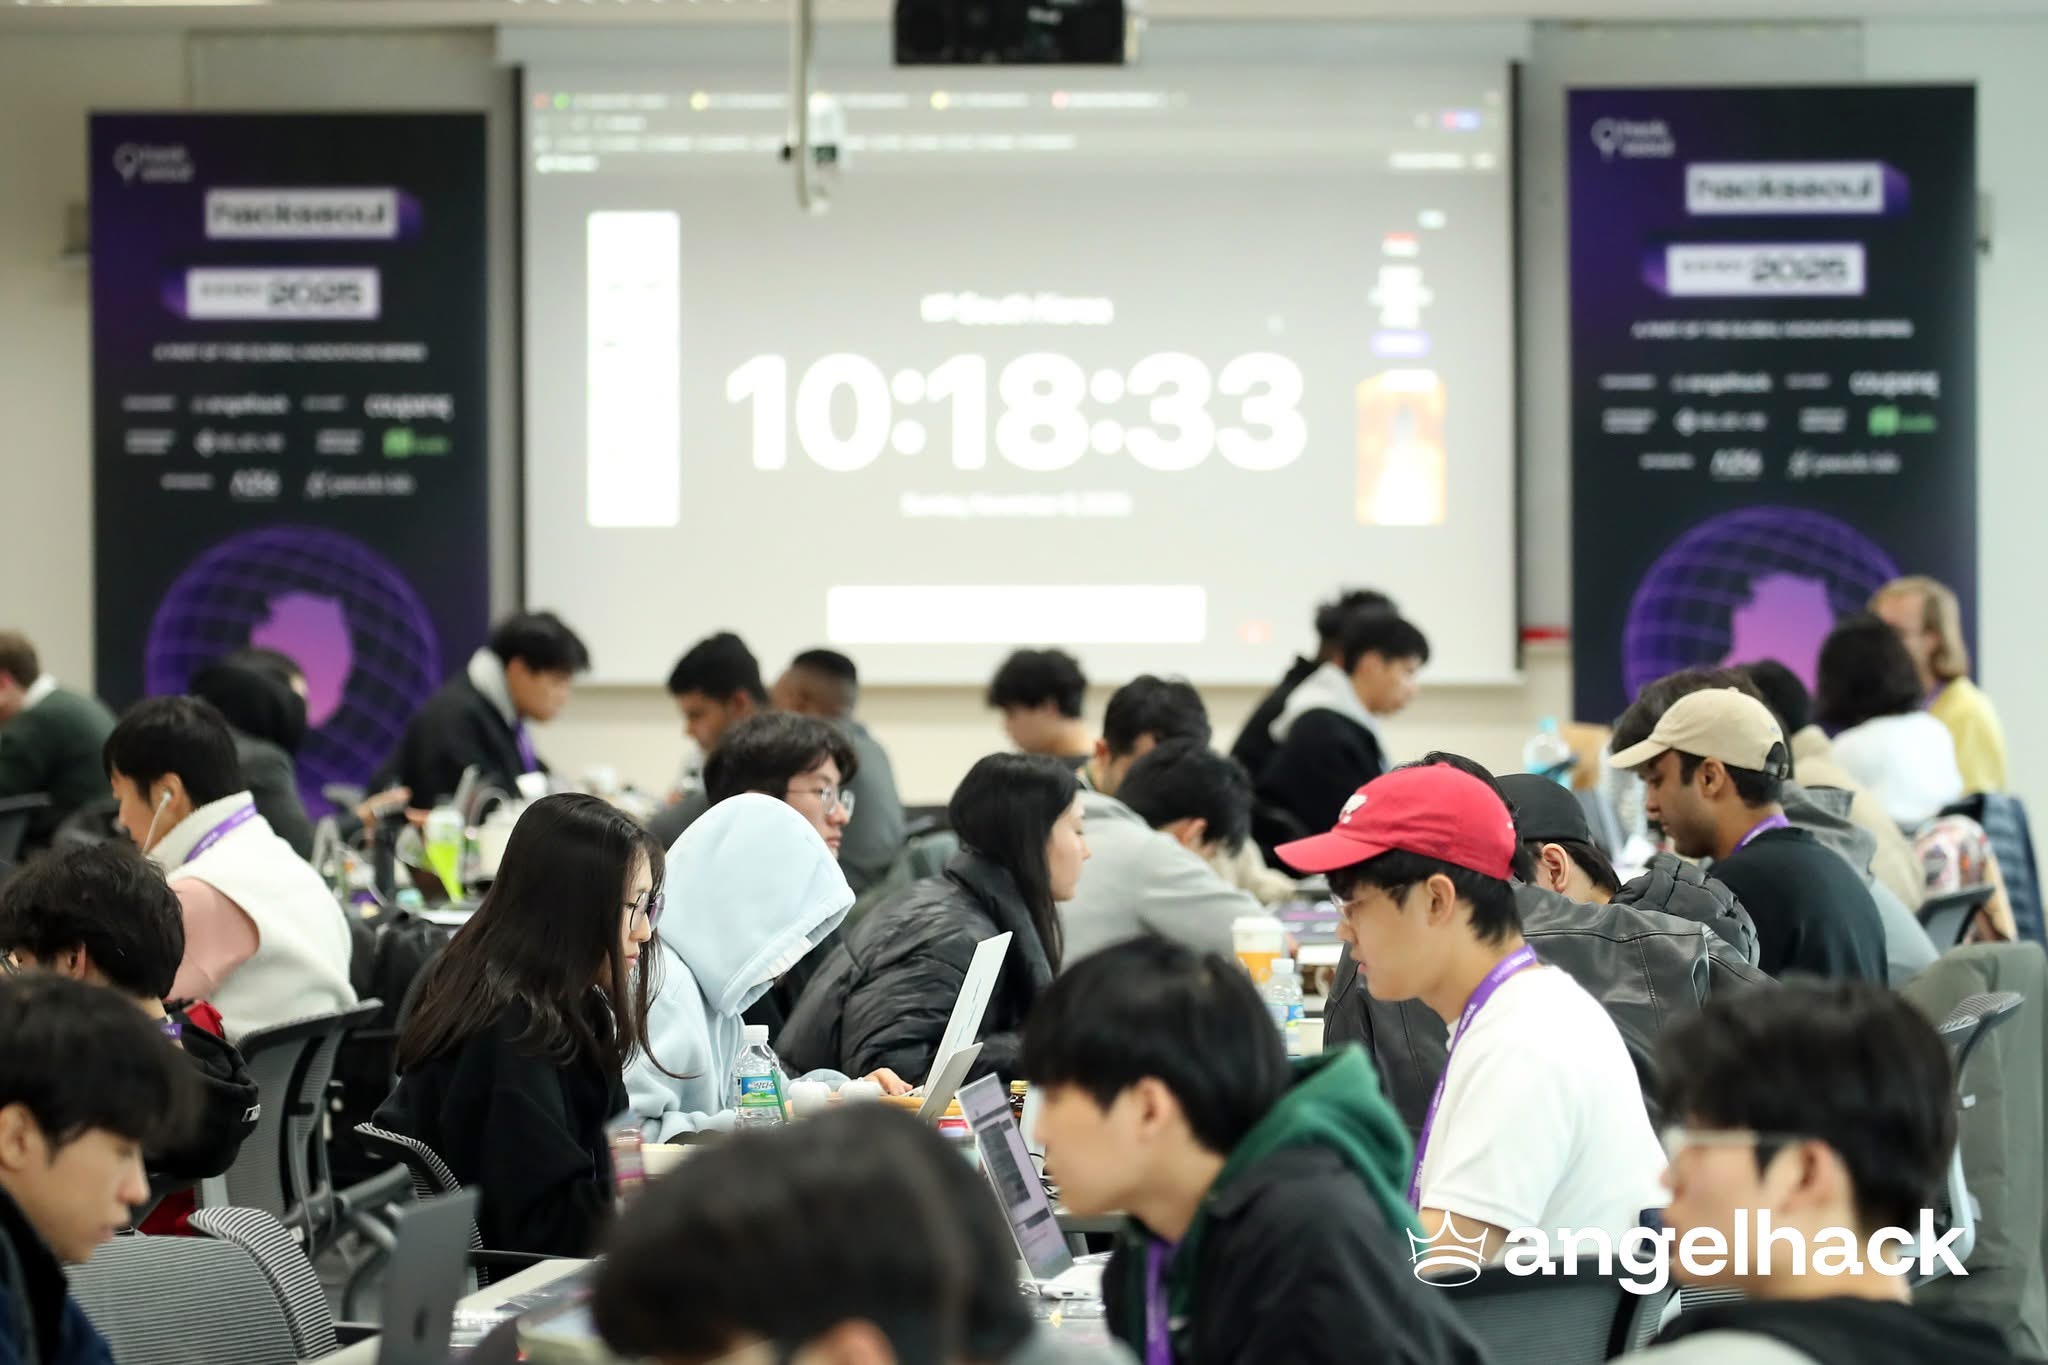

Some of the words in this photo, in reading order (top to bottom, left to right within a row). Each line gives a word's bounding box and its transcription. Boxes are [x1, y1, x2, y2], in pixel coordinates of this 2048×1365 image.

[1698, 177, 1873, 200] hackseoul
[214, 202, 385, 223] hackseoul
[1752, 255, 1848, 283] 2025
[269, 279, 362, 306] 2025
[726, 352, 1307, 472] 10:18:33
